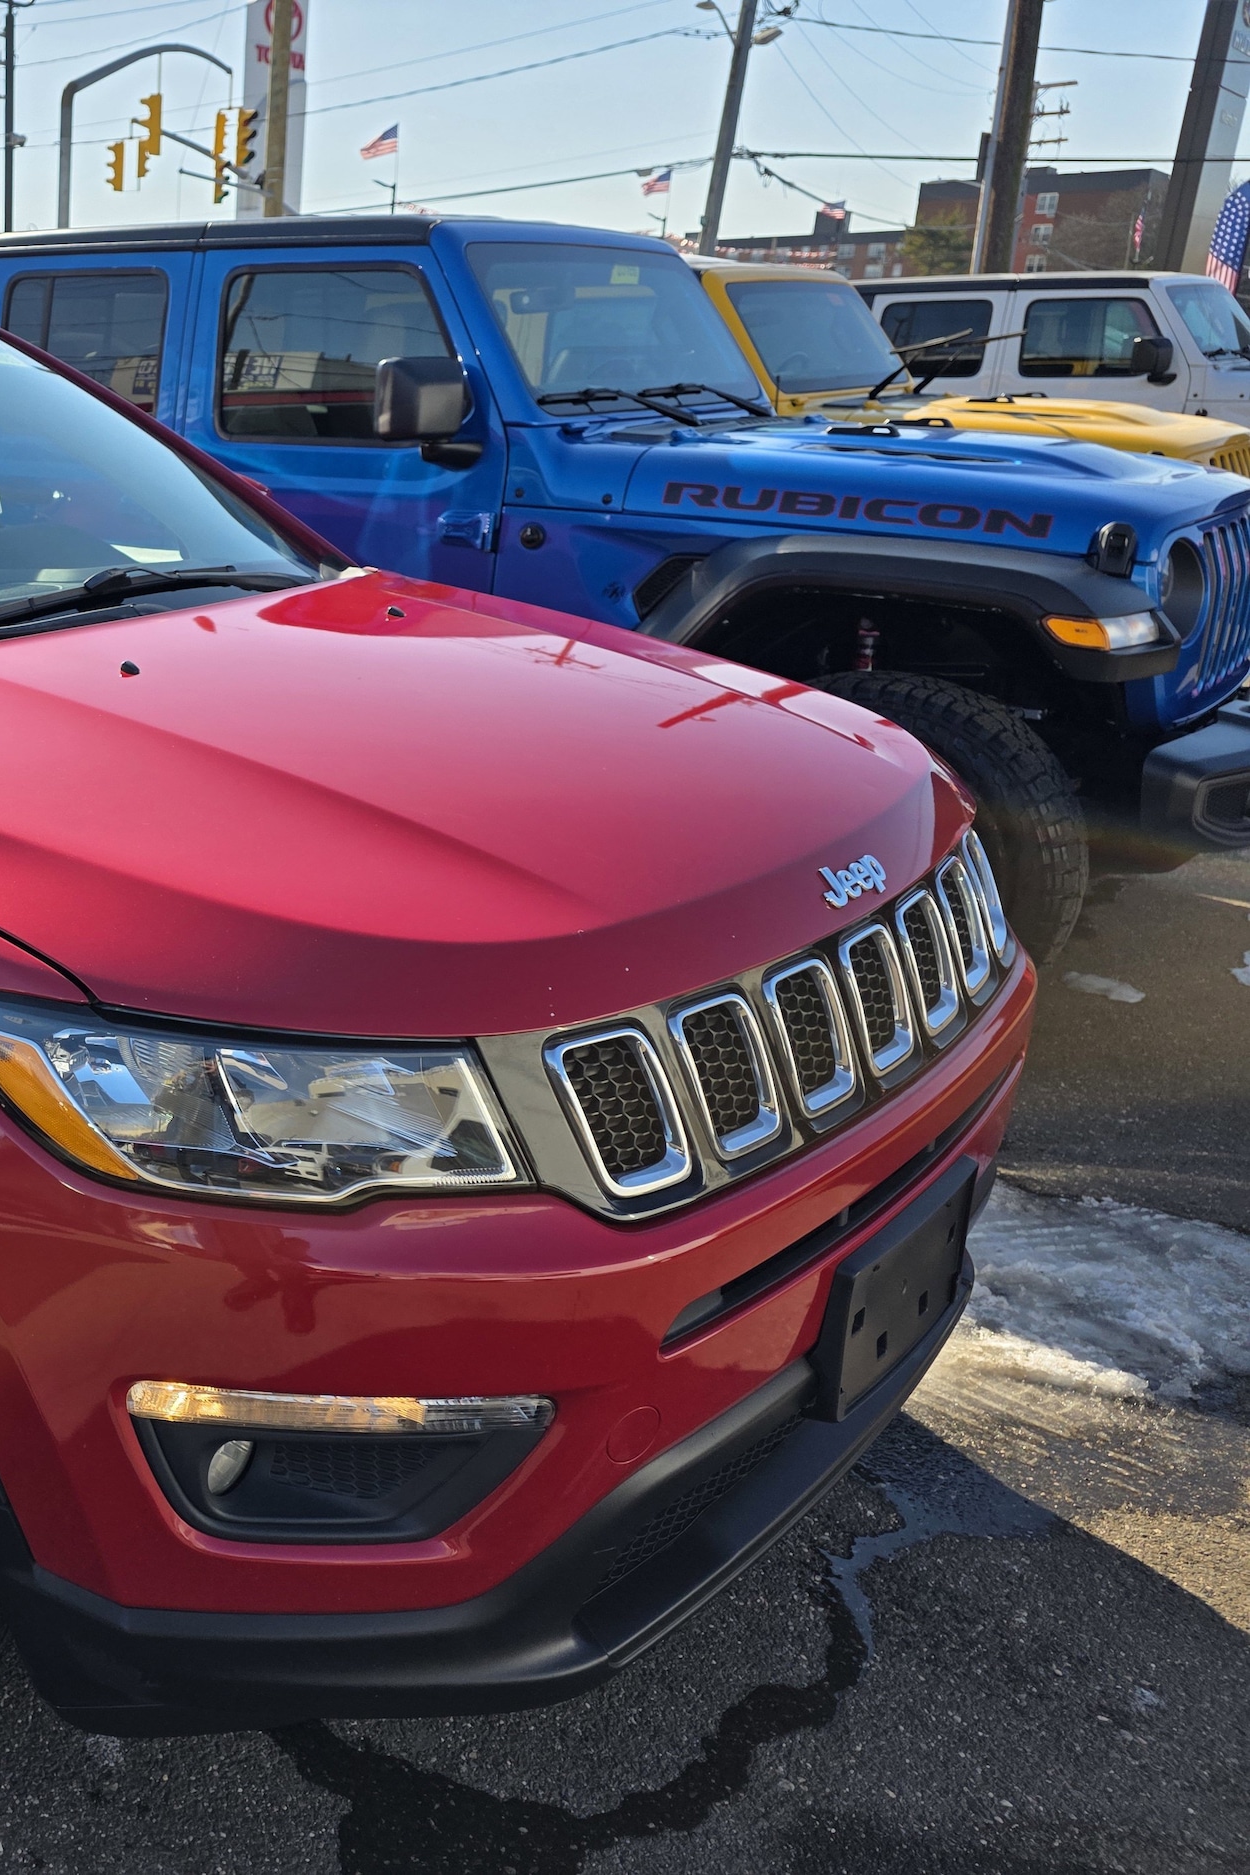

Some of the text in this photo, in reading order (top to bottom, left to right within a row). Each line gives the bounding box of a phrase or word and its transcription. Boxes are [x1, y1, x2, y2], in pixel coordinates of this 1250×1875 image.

[255, 44, 306, 71] TOTA
[662, 482, 1054, 539] RUBICON
[818, 854, 887, 908] Jeep
